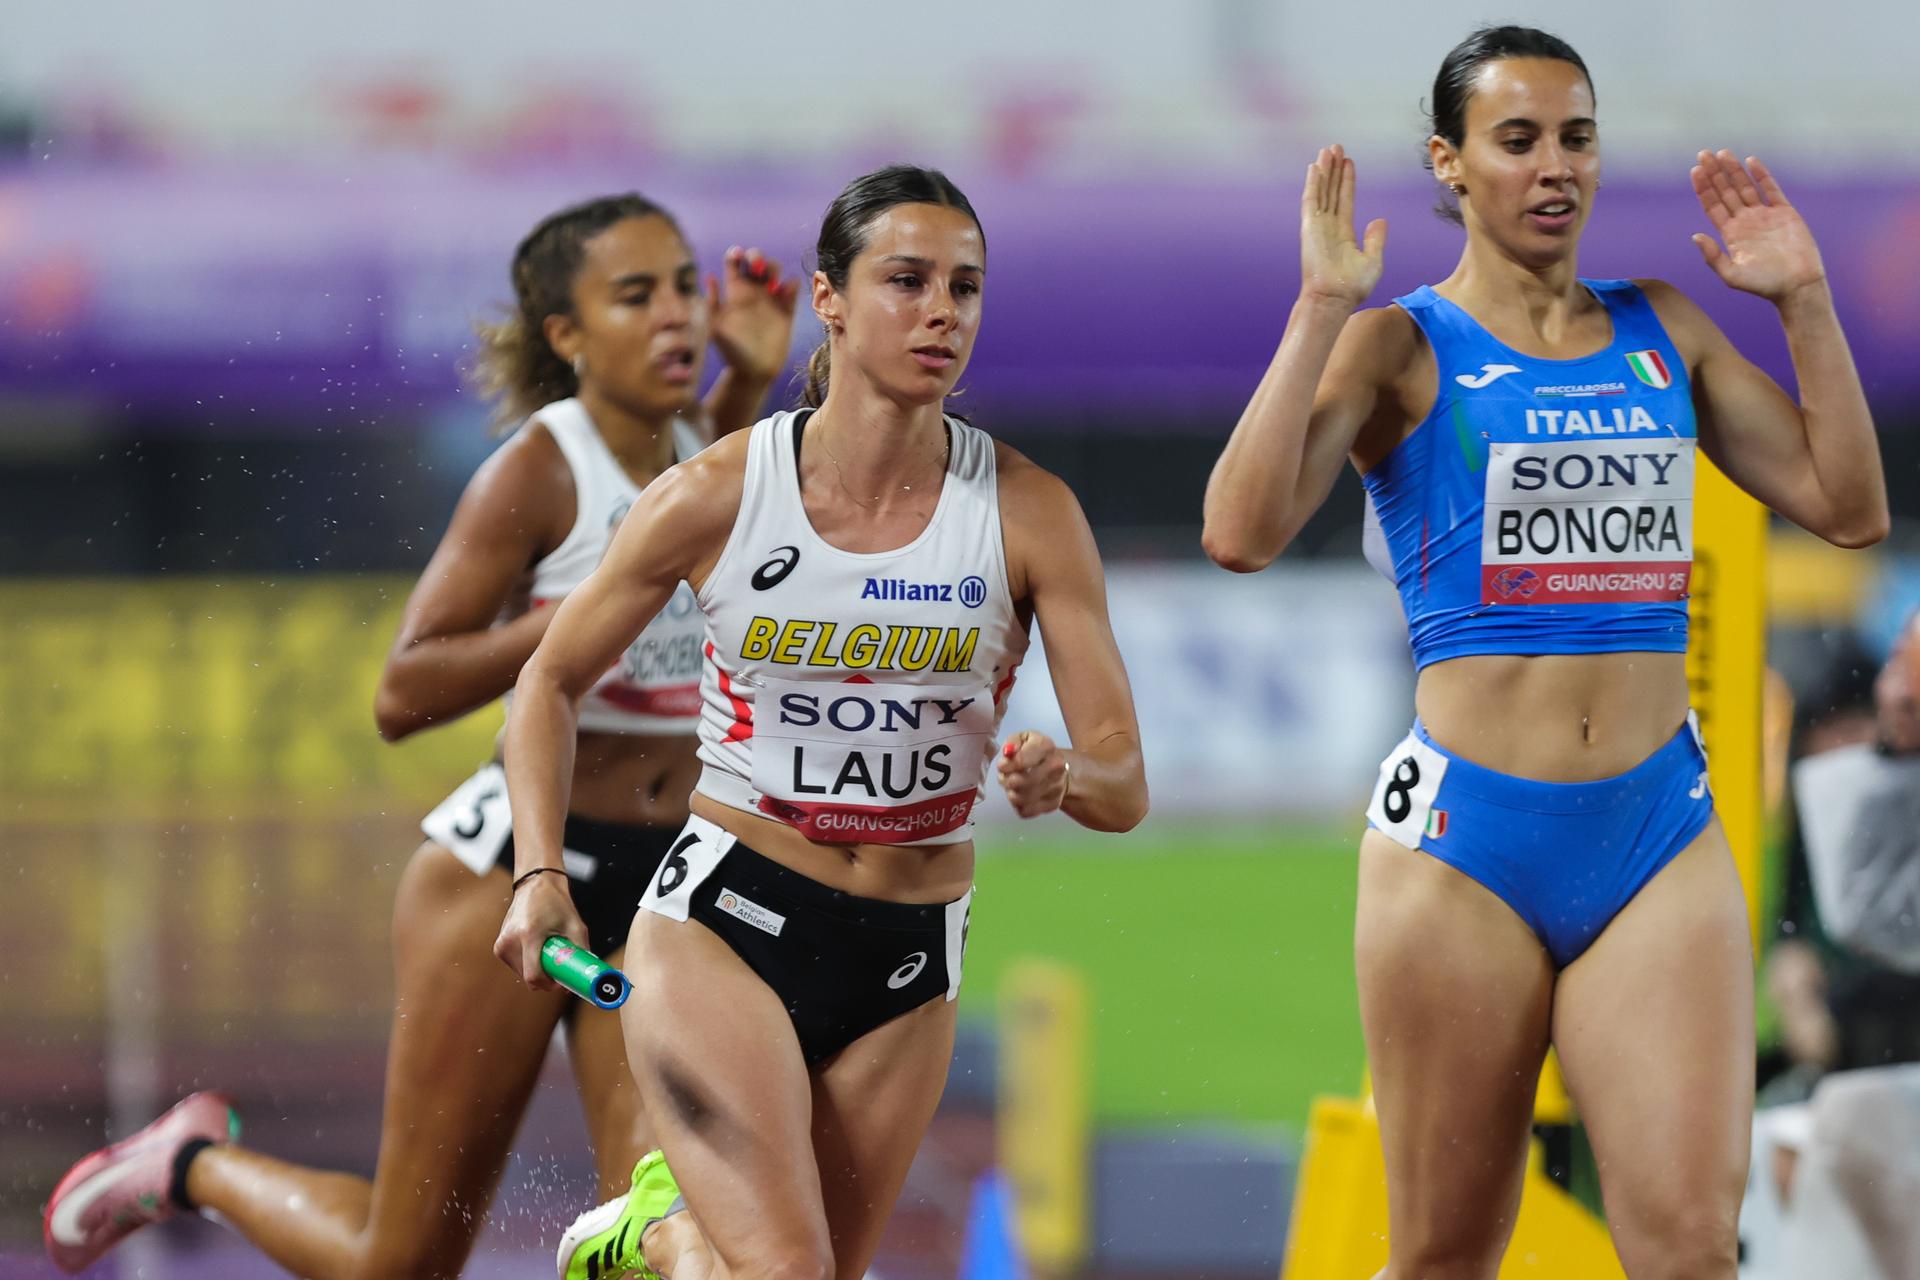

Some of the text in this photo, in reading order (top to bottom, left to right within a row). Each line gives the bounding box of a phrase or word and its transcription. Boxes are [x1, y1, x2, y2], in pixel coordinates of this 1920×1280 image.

[1534, 382, 1626, 394] FRECCIAROSSA
[1526, 406, 1658, 435] ITALIA
[1512, 453, 1678, 491] SONY
[1497, 506, 1683, 556] BONORA
[861, 578, 953, 602] Allianz
[1546, 572, 1685, 592] GUANGZHOU 25
[739, 616, 980, 673] BELGIUM
[779, 693, 975, 732] SONY
[793, 744, 952, 798] LAUS
[1383, 754, 1420, 823] 8
[815, 802, 969, 832] GUANGZHOU 25
[656, 832, 702, 898] 6
[736, 908, 778, 933] Athletics
[740, 900, 766, 916] Belgian
